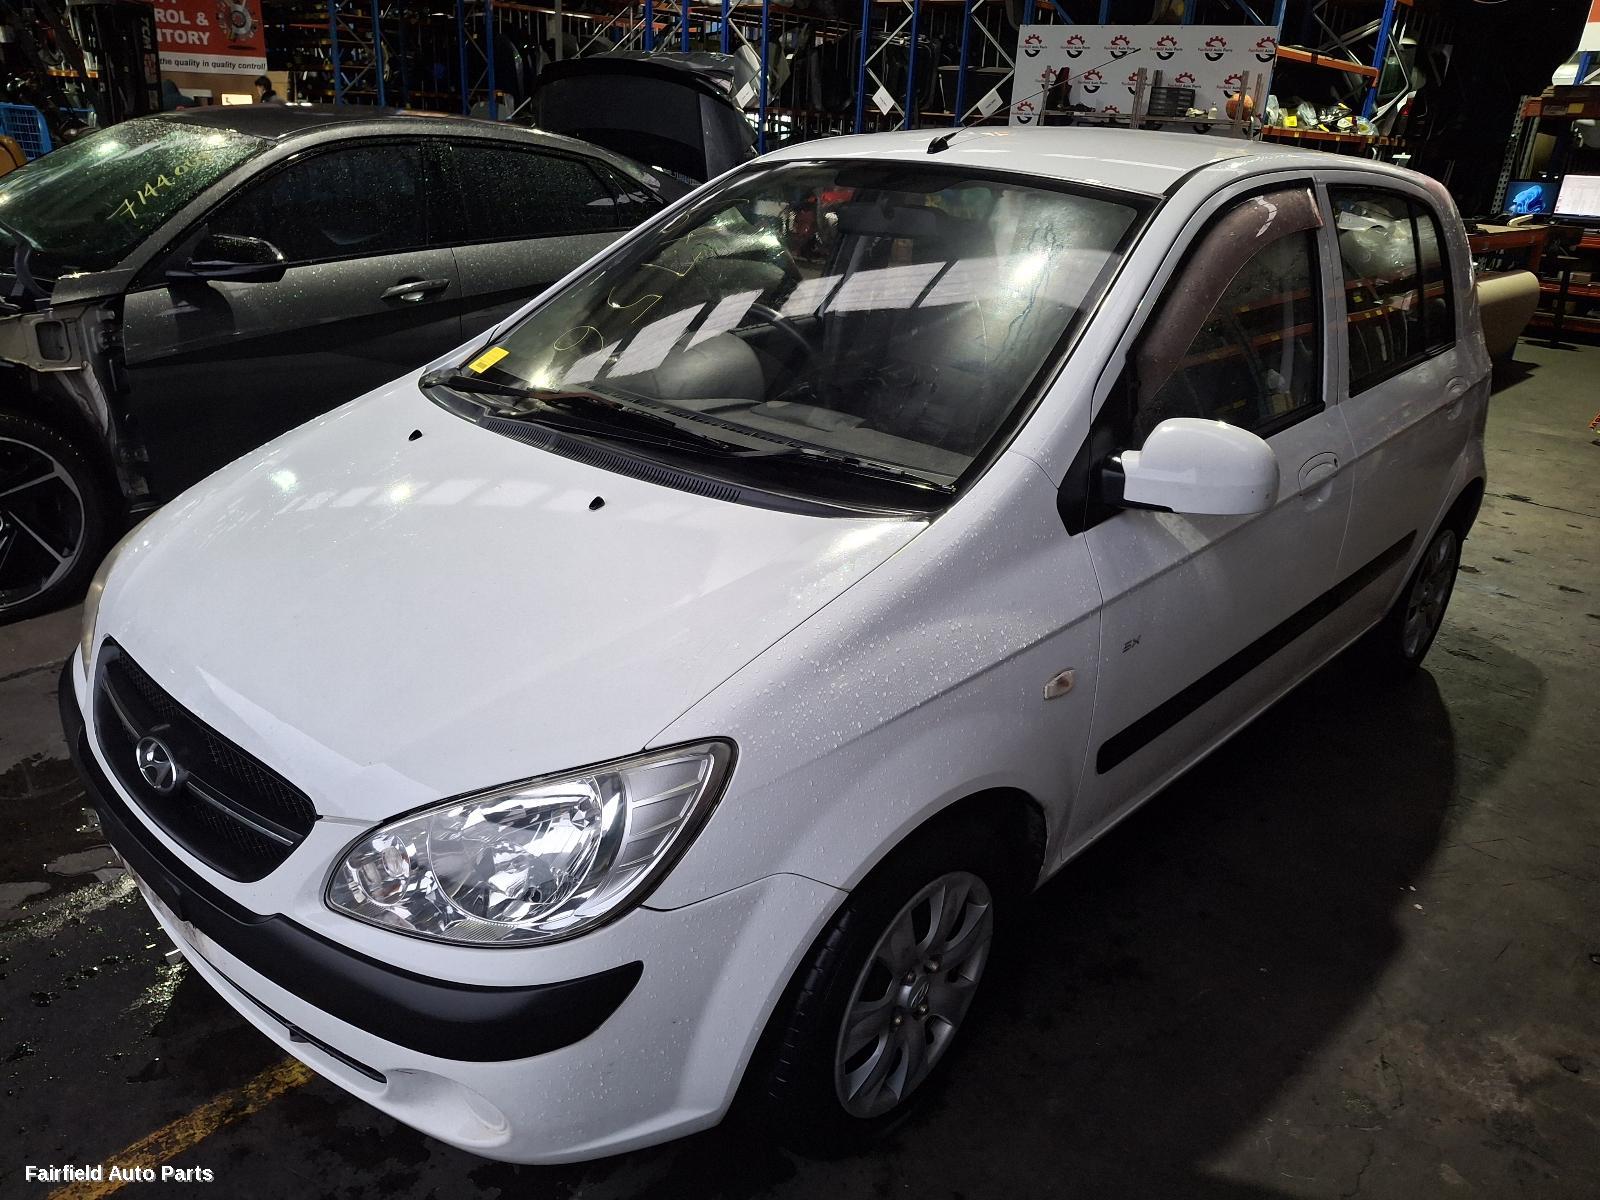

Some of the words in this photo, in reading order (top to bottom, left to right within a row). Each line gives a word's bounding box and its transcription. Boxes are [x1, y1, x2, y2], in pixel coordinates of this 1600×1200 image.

[195, 11, 209, 26] &
[174, 58, 200, 69] quality
[202, 59, 210, 67] in
[211, 61, 236, 70] quality
